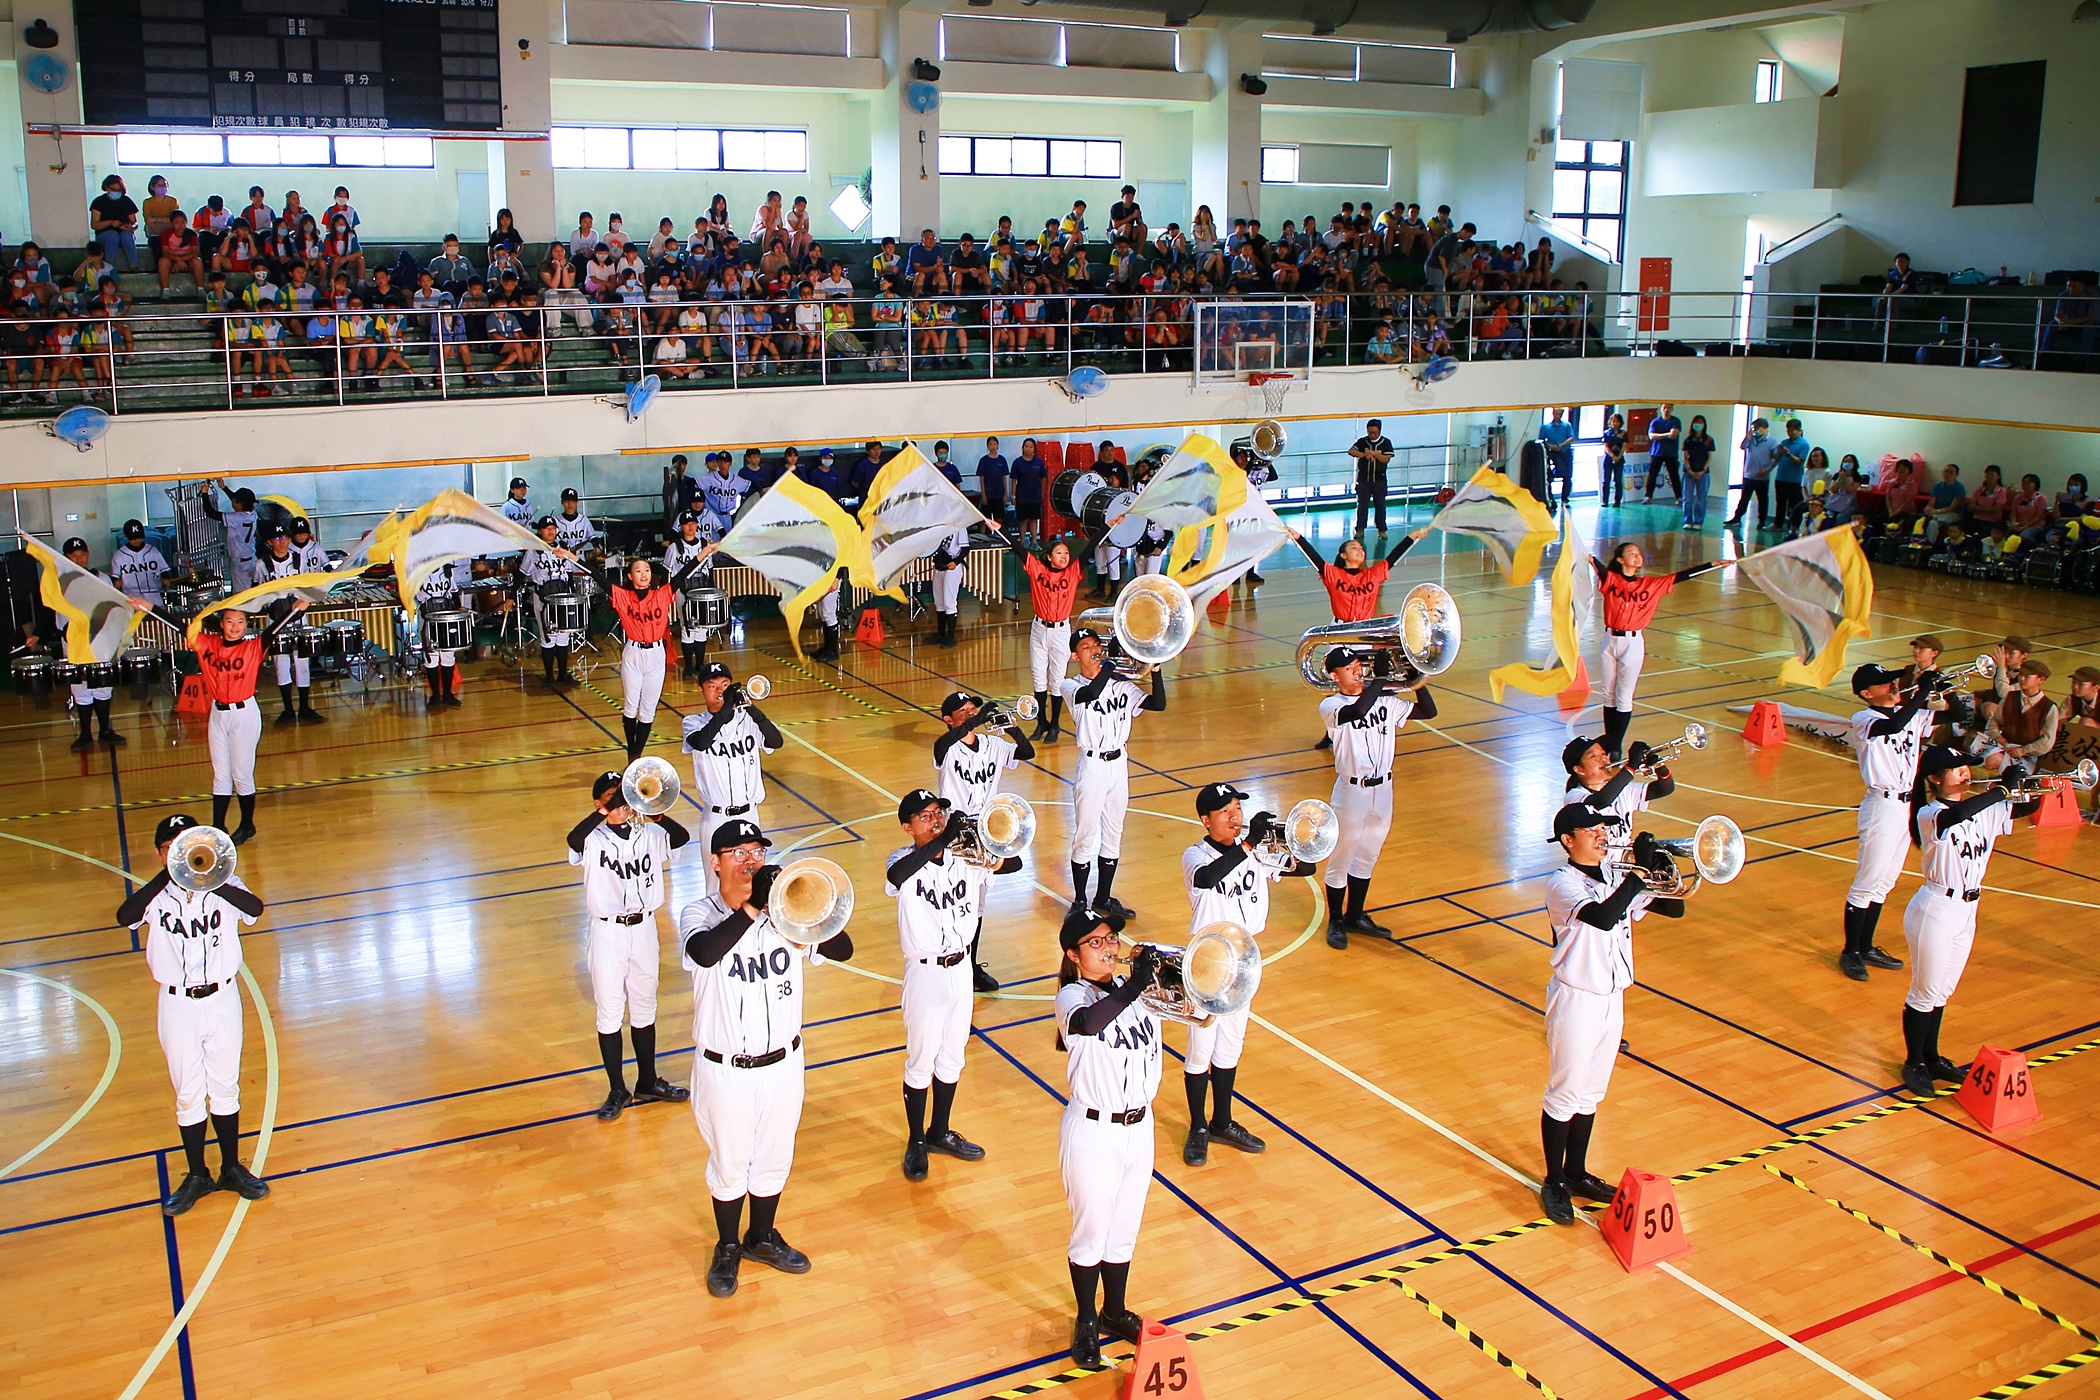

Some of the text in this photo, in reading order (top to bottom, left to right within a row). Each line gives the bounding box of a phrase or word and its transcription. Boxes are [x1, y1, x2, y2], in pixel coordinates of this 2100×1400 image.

[229, 71, 370, 85] 得分 局數 得分
[214, 116, 389, 128] 犯規次數 球員犯規次數 犯規次數
[709, 486, 737, 496] KANO
[120, 561, 158, 574] KANO
[1336, 579, 1374, 596] KANO
[1609, 584, 1649, 602] KANO
[627, 605, 662, 623] KANO
[862, 618, 875, 629] 45
[1078, 628, 1089, 638] K
[1342, 649, 1354, 657] K
[711, 664, 721, 672] K
[184, 684, 198, 698] 40
[1754, 712, 1760, 727] 2
[1771, 714, 1777, 729] 2
[607, 772, 620, 780] K
[919, 790, 933, 800] K
[1216, 784, 1232, 797] K
[1585, 804, 1600, 815] K
[170, 816, 184, 827] K
[739, 823, 754, 836] K
[600, 850, 651, 880] KANO
[916, 878, 966, 910] KANO
[1250, 892, 1258, 903] 6
[1084, 910, 1102, 921] K
[159, 909, 221, 938] KANO
[728, 947, 791, 983] ANO
[777, 981, 793, 1000] 38
[1972, 1064, 1996, 1096] 45
[2003, 1070, 2027, 1100] 45
[1615, 1190, 1634, 1232] 50
[1644, 1203, 1673, 1239] 50
[1144, 1356, 1187, 1396] 45
